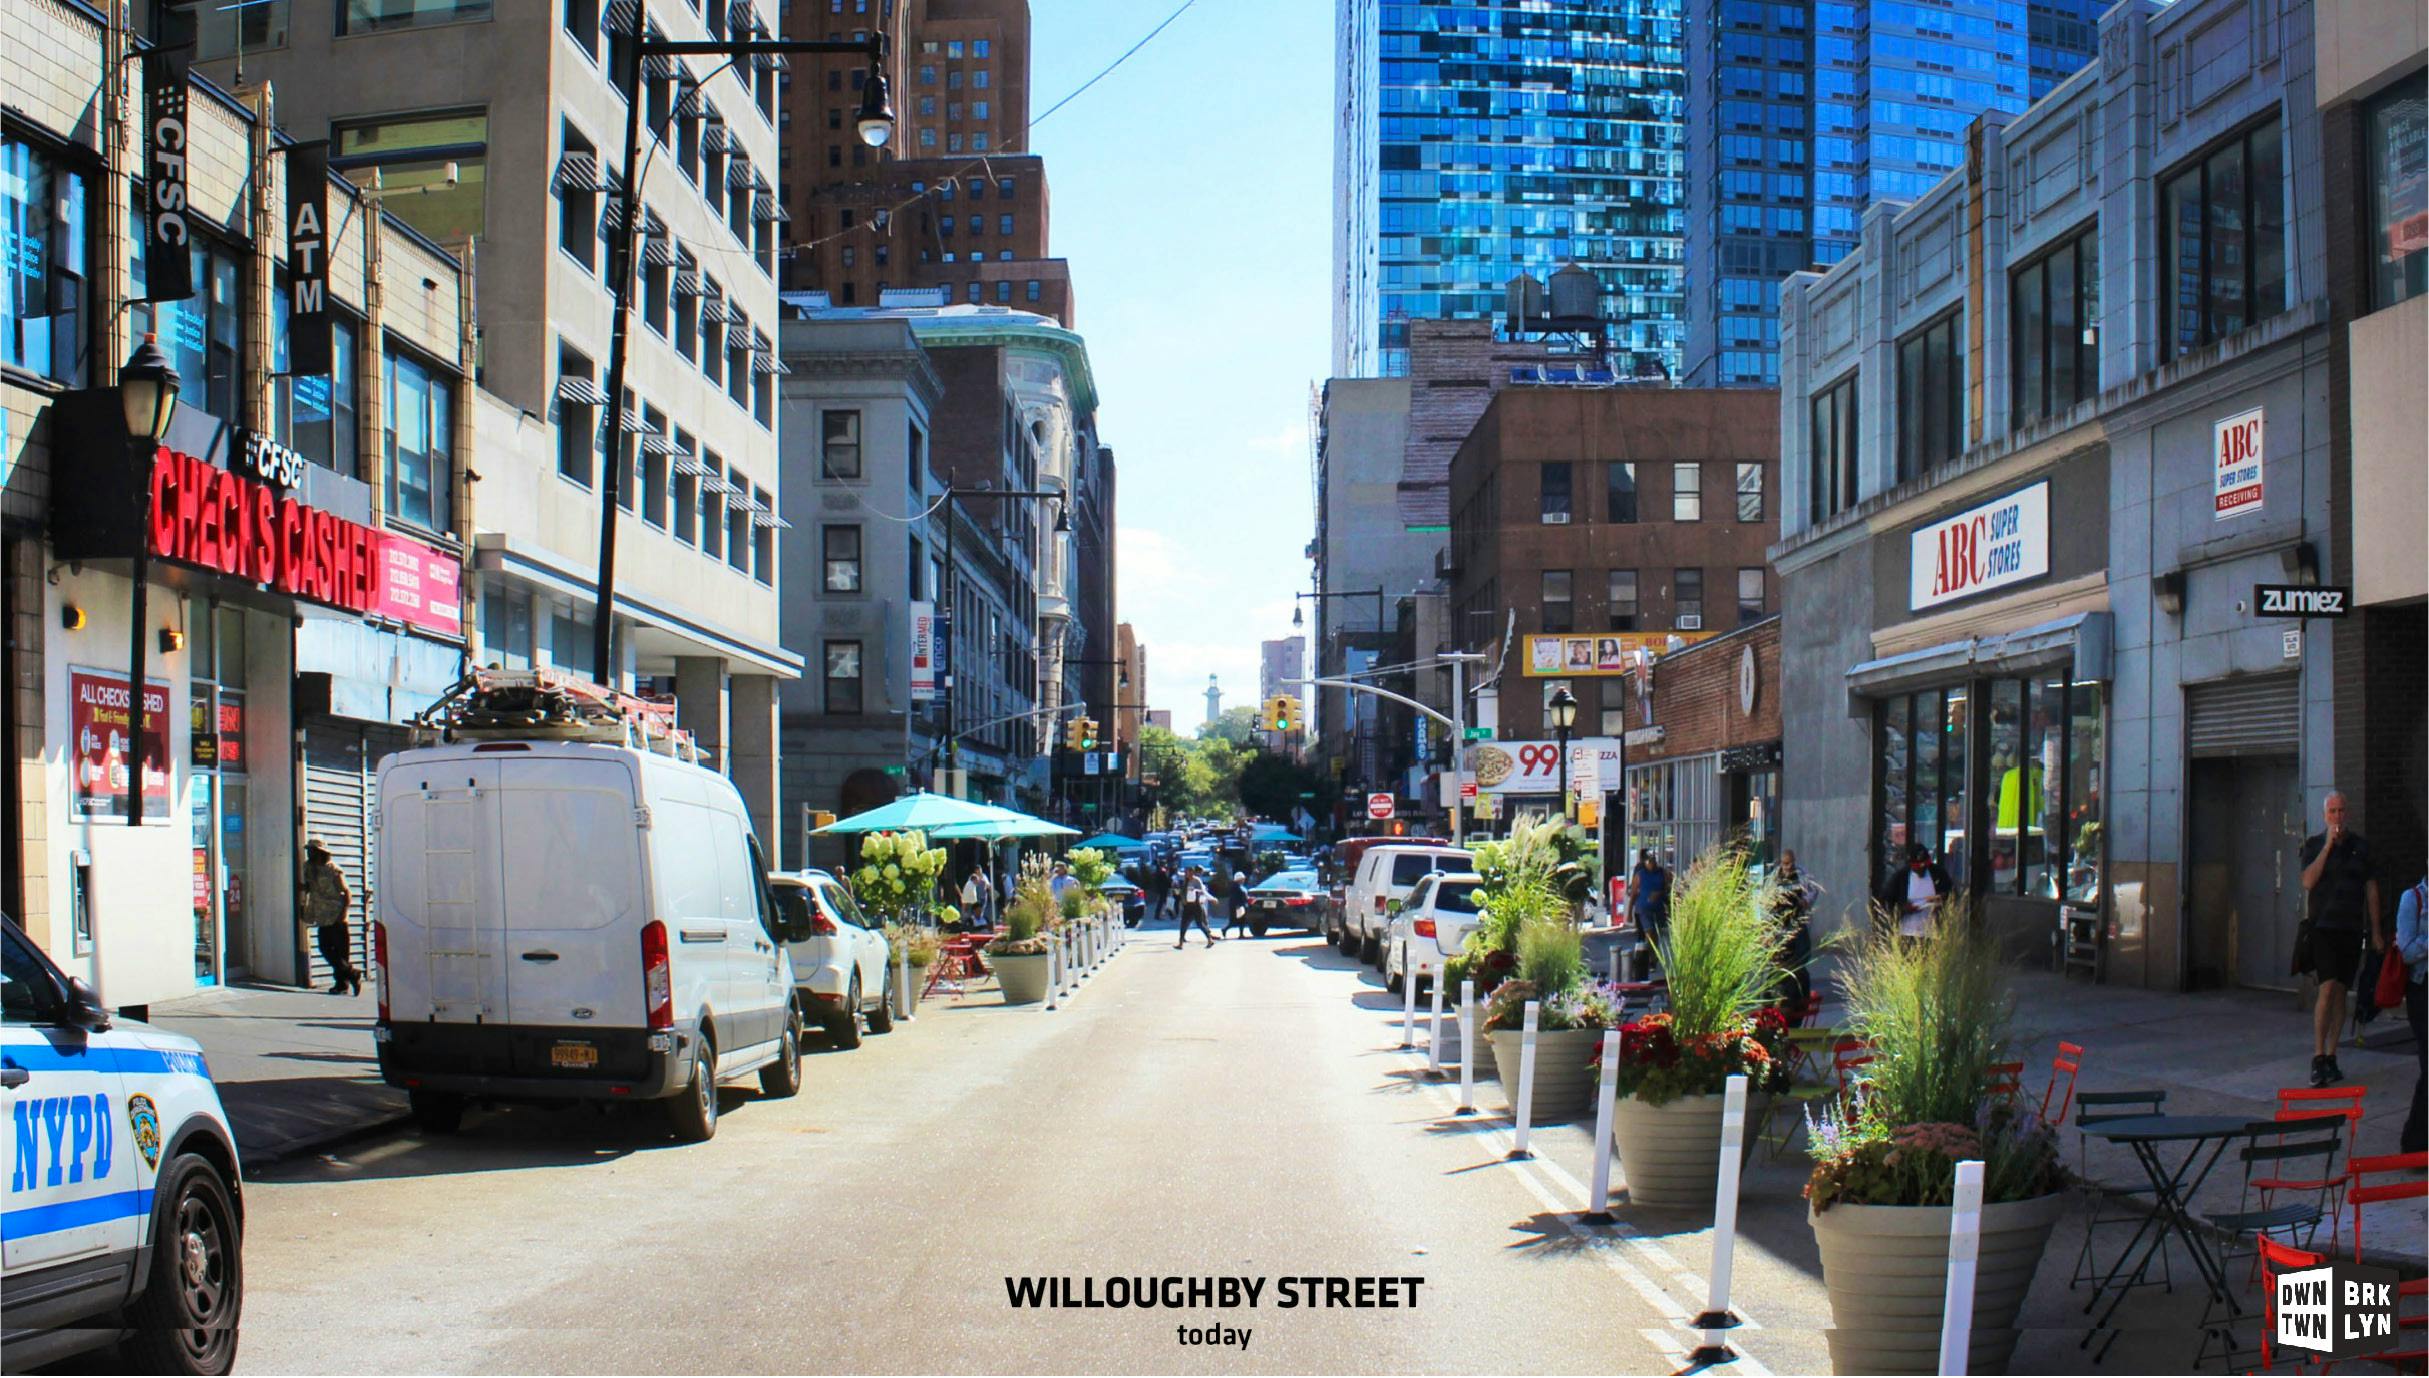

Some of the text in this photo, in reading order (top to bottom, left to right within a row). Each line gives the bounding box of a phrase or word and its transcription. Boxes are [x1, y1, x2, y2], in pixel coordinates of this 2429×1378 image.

[156, 117, 188, 246] CFSC
[295, 202, 323, 314] ATM
[258, 438, 303, 489] CFSC
[2219, 420, 2258, 468] ABC
[2219, 487, 2258, 508] RECEIVING
[2220, 471, 2236, 488] SUPER
[152, 445, 380, 612] CHECKS CASHED
[1990, 504, 2019, 542] SUPER
[1932, 513, 1986, 597] ABC
[1987, 539, 2021, 579] STORES
[2263, 589, 2344, 614] zumiez
[80, 683, 96, 704] ALL
[97, 686, 130, 708] CHECKS
[1469, 730, 1480, 738] Jay
[1519, 744, 1559, 776] 99
[12, 1093, 112, 1193] NYPD
